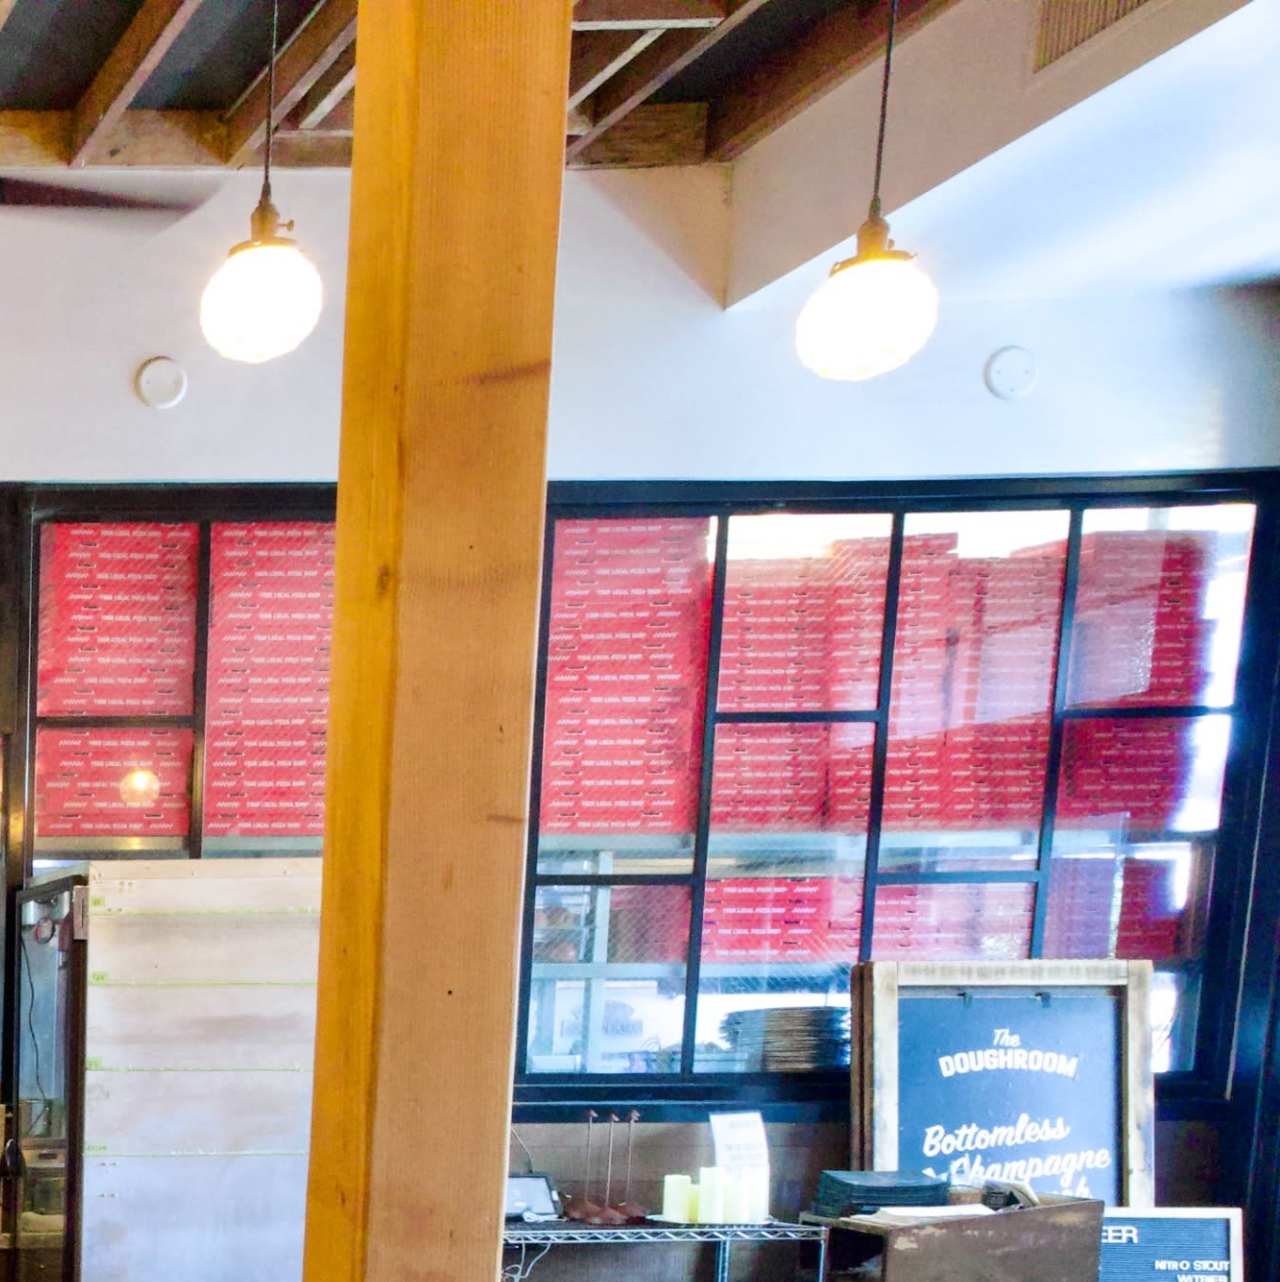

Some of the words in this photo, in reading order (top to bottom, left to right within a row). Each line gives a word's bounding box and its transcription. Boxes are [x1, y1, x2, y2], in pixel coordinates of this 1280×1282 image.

[992, 1028, 1021, 1047] The
[938, 1048, 1079, 1079] DOUGHROOM
[922, 1112, 1071, 1158] Bottomless
[948, 1146, 1111, 1187] Champagne
[1193, 1260, 1230, 1271] STOUT
